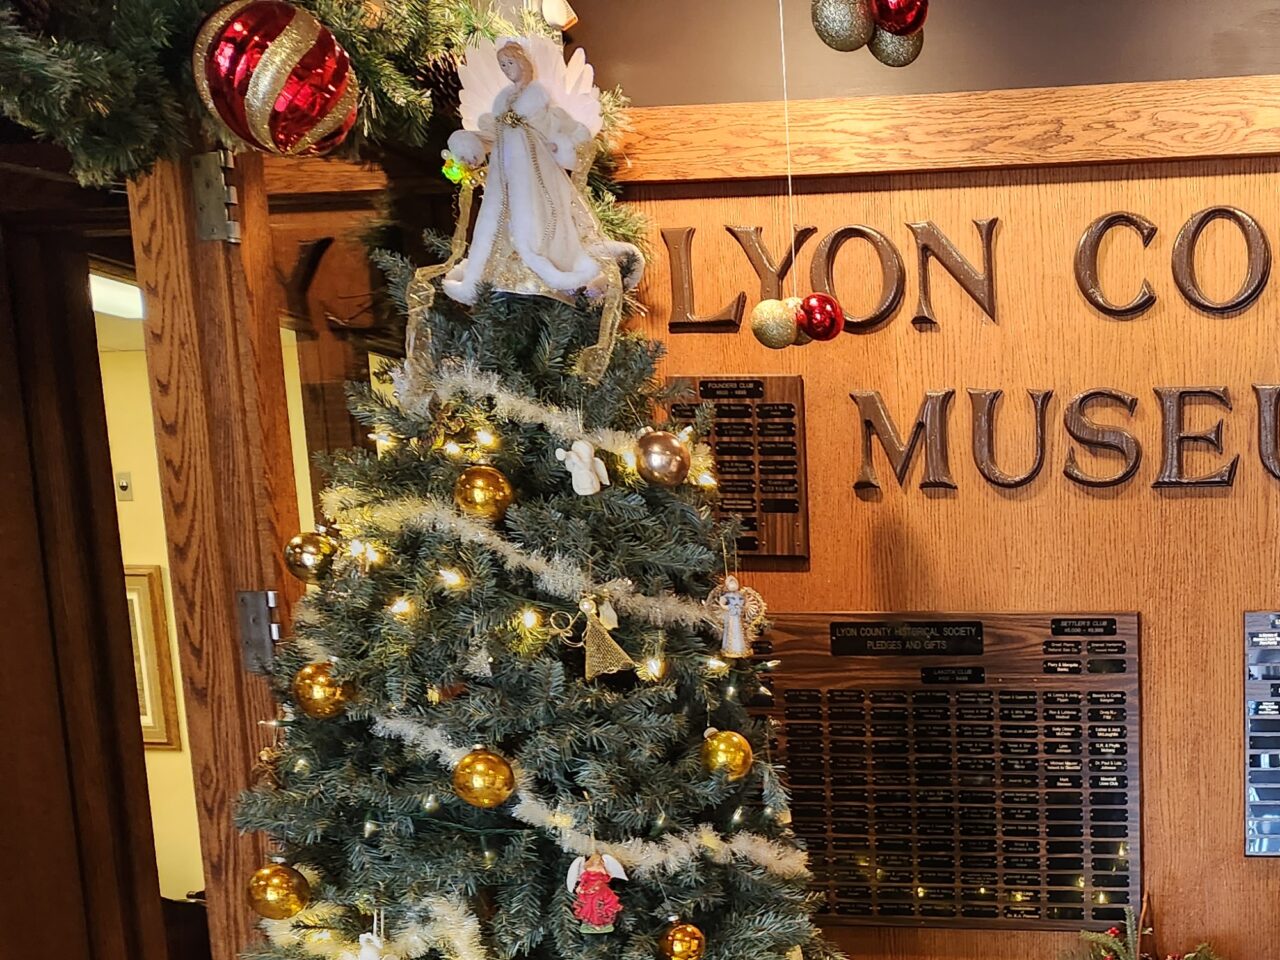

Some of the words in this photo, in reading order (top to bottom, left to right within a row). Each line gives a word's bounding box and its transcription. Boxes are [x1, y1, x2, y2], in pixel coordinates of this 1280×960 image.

[666, 216, 1000, 334] LYON
[836, 628, 857, 636] LYON
[860, 627, 891, 636] COUNTY
[943, 626, 977, 636] SOCIETY
[866, 641, 902, 649] PLEDGES
[906, 641, 921, 649] AND
[924, 641, 947, 649] GIFTS
